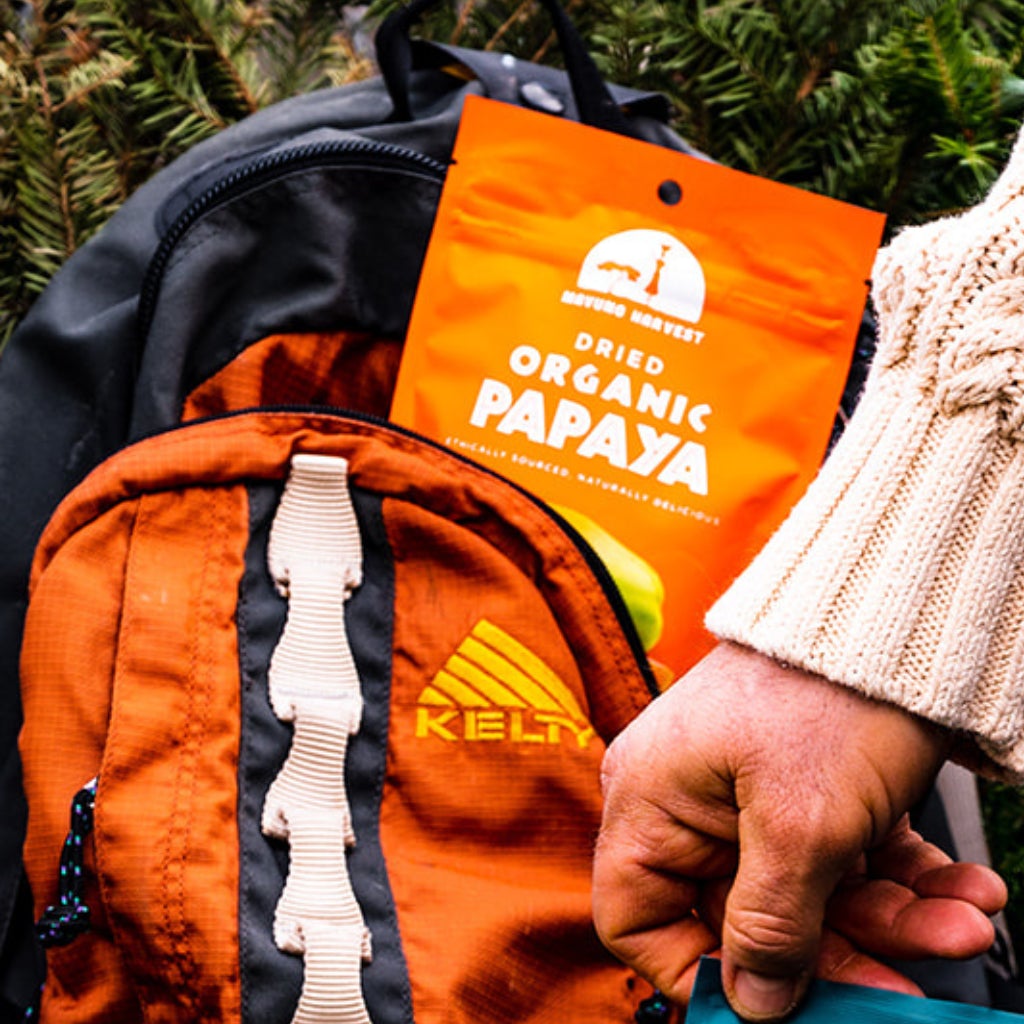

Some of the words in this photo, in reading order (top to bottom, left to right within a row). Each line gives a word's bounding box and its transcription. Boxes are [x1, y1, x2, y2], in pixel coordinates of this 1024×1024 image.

[561, 290, 627, 320] MAVUNO
[631, 310, 706, 345] HARVEST
[574, 331, 665, 376] DRIED
[508, 345, 713, 434] ORGANIC
[469, 378, 709, 496] PAPAYA
[415, 707, 596, 749] KELTY
